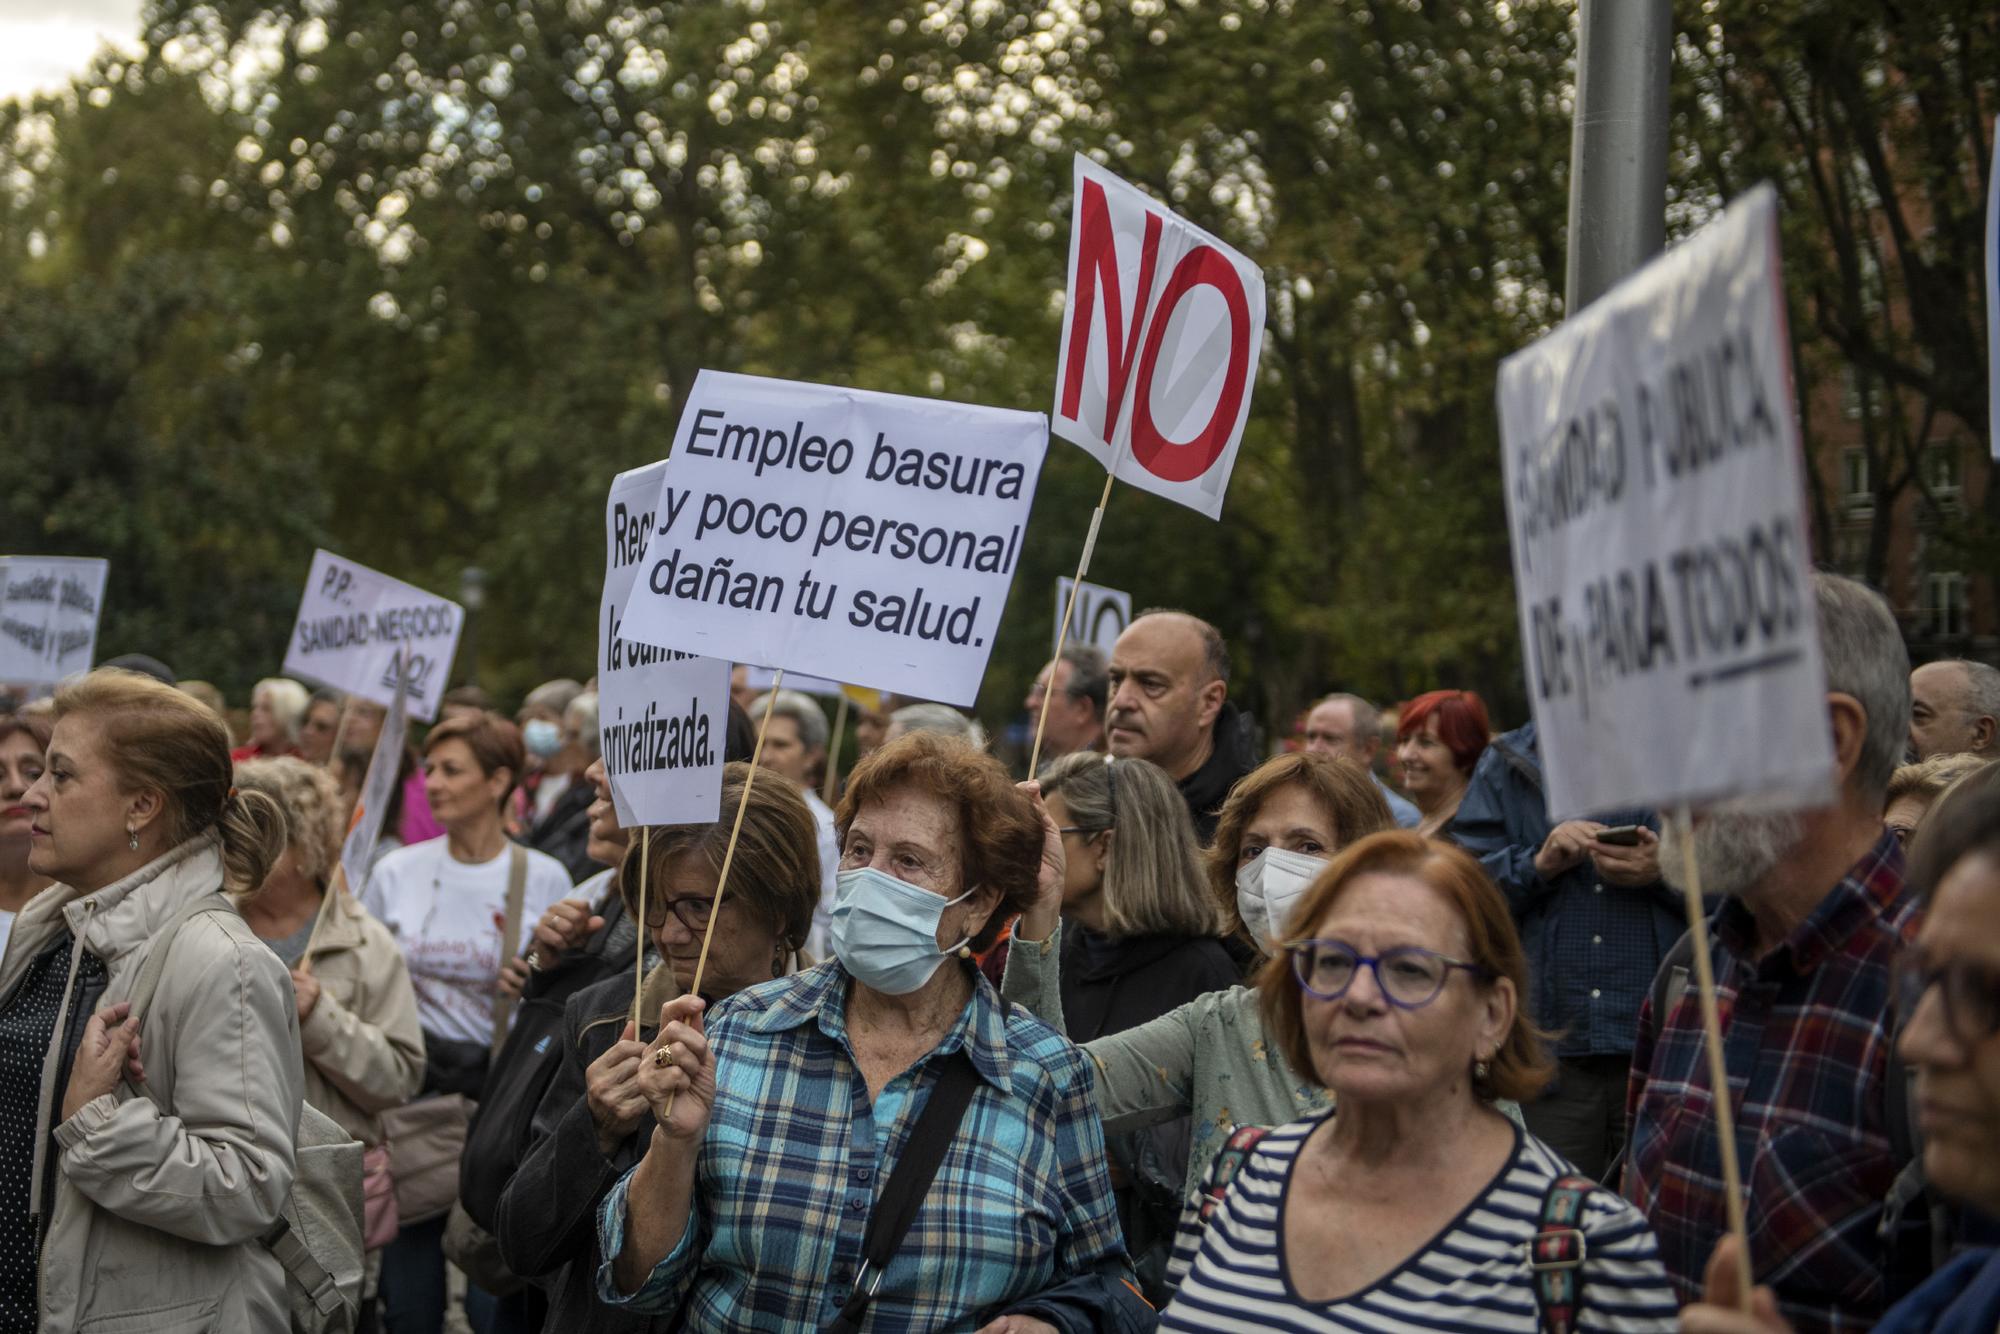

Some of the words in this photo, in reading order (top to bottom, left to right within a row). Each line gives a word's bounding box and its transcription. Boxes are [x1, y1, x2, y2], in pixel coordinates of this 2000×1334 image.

[1061, 176, 1250, 482] NO
[686, 408, 853, 477] Empleo
[866, 433, 1025, 500] basura
[614, 502, 655, 568] Rec
[659, 487, 691, 535] y
[695, 492, 808, 542] poco
[813, 509, 1020, 575] personal
[607, 604, 623, 672] la
[649, 548, 785, 613] dañan
[798, 569, 837, 620] tu
[848, 587, 983, 647] salud.
[1064, 587, 1125, 645] NO
[1583, 560, 1677, 685] PARA
[603, 697, 714, 795] privatizada.
